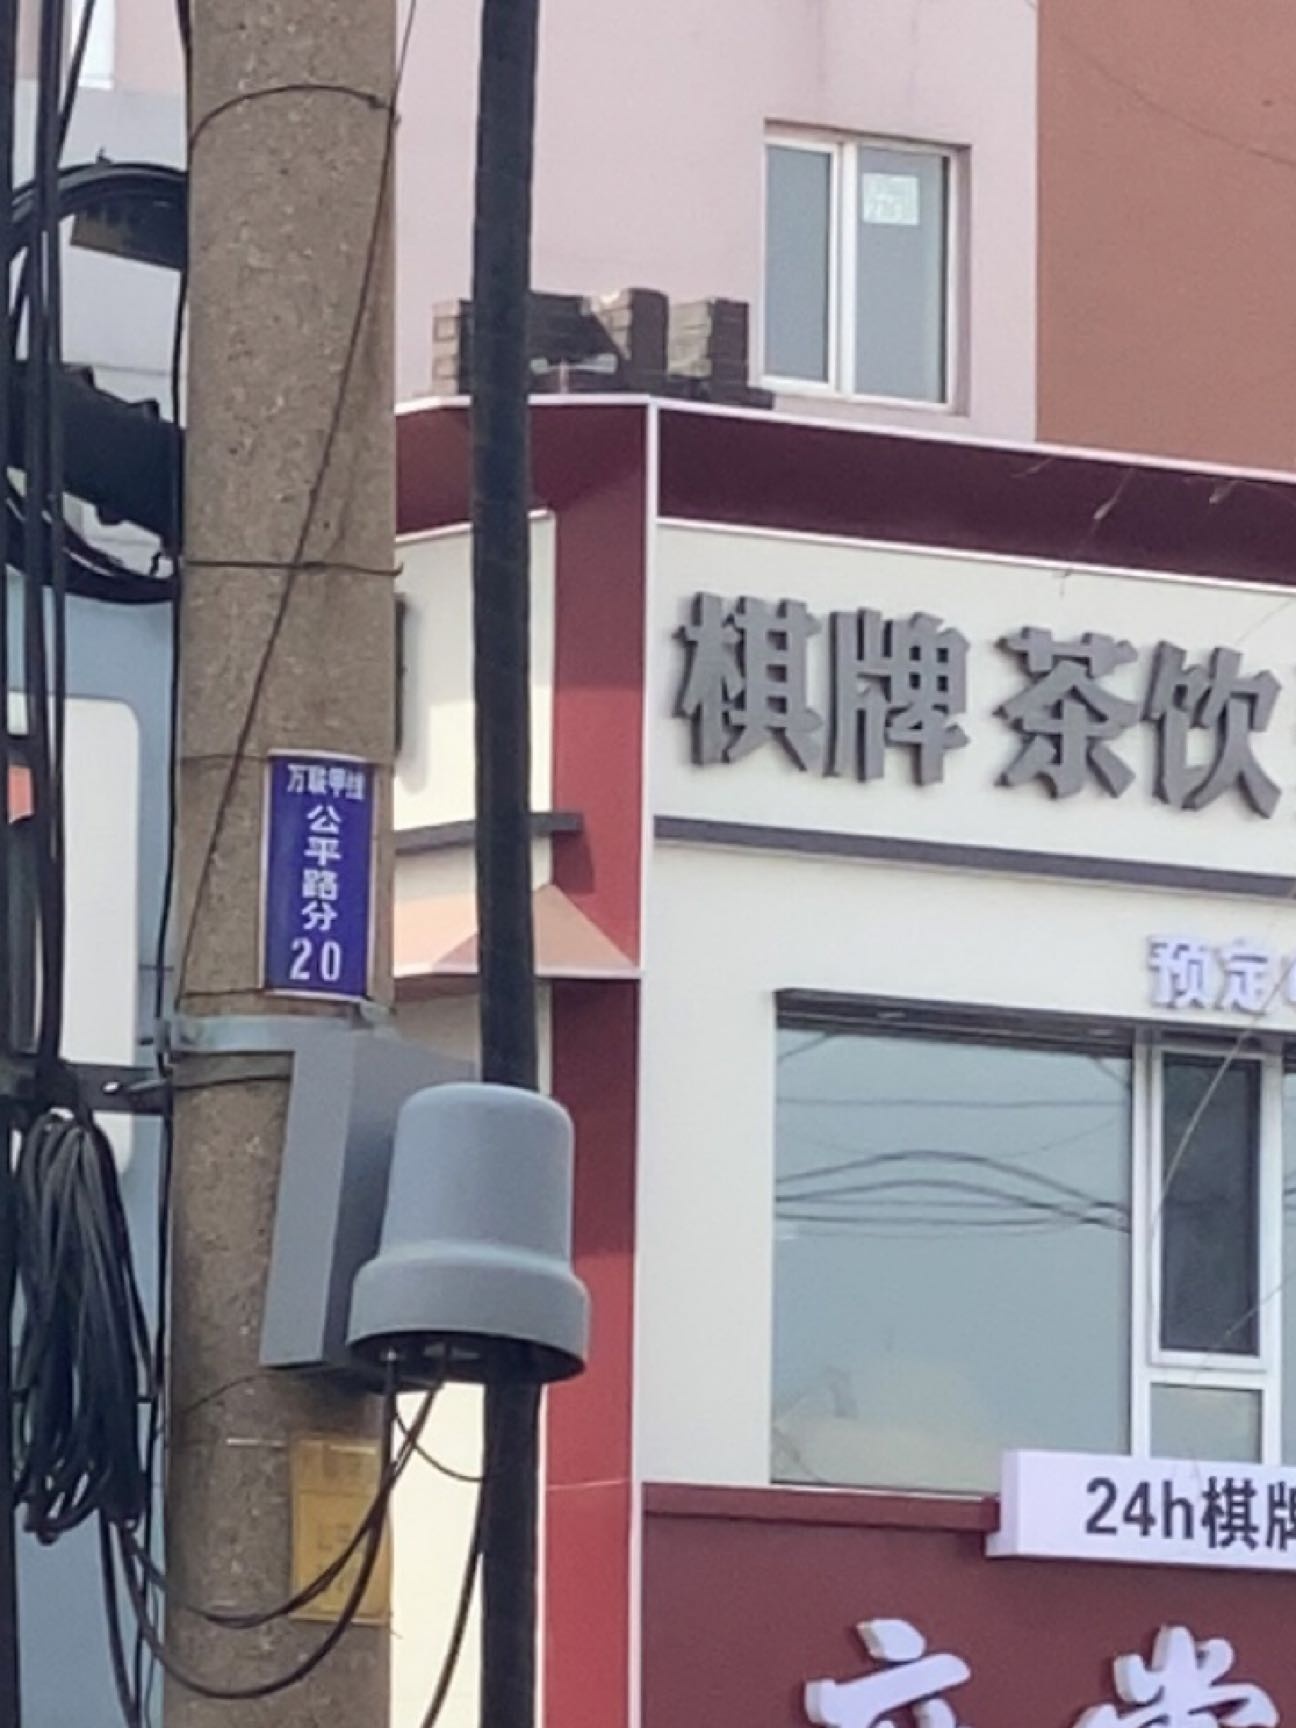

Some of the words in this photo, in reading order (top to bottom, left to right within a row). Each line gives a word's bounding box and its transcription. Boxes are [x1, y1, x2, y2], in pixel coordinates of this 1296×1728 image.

[300, 804, 342, 931] 公平路分
[290, 937, 341, 982] 20
